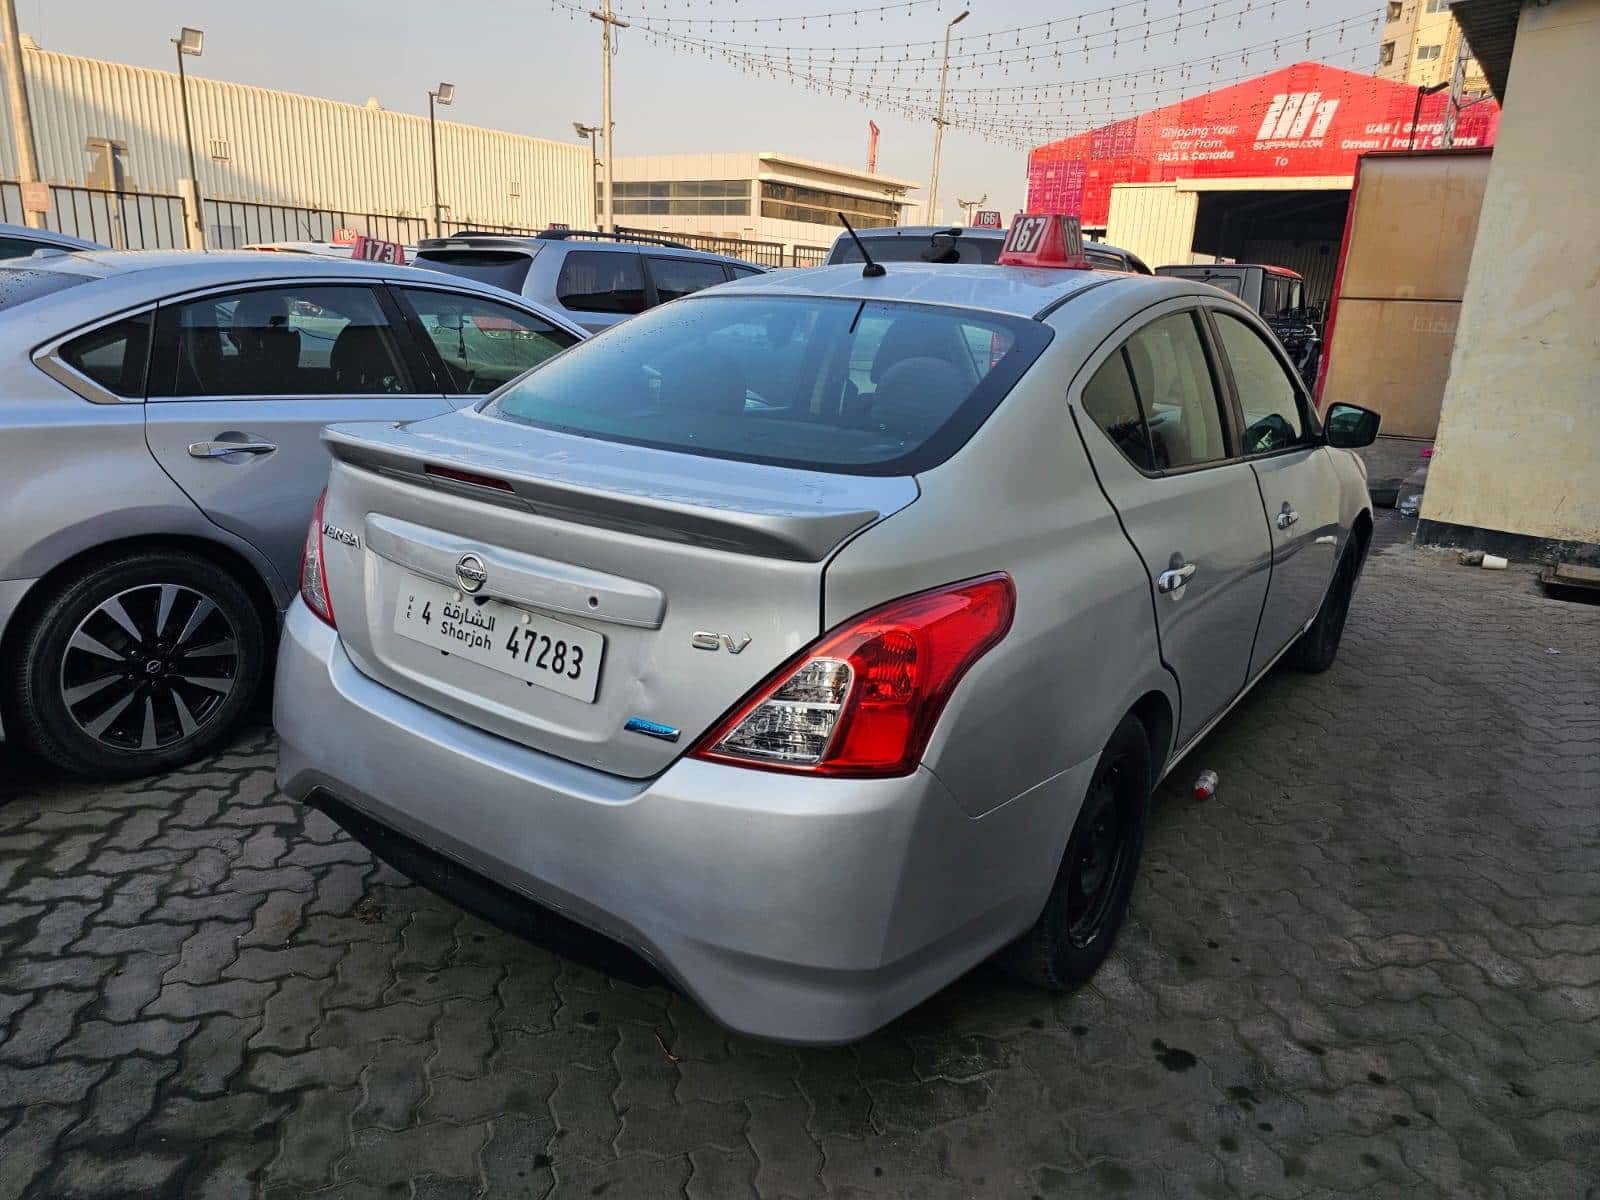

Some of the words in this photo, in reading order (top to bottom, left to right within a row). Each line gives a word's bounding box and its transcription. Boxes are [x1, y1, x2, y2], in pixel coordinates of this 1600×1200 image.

[1161, 126, 1209, 139] Shipping
[1212, 124, 1239, 135] Your
[1157, 152, 1179, 161] USA
[1191, 150, 1235, 161] Canada
[1171, 140, 1192, 150] Car
[1194, 139, 1223, 149] From
[1341, 139, 1380, 149] Oman
[1274, 156, 1289, 168] To
[980, 212, 996, 225] 166
[1008, 217, 1046, 252] 167
[365, 240, 395, 264] 173
[322, 521, 361, 550] VERSA
[421, 601, 431, 625] 4
[443, 601, 496, 632] الشارقة
[441, 621, 492, 650] Sharjah
[691, 630, 752, 654] SV
[505, 625, 584, 680] 47283
